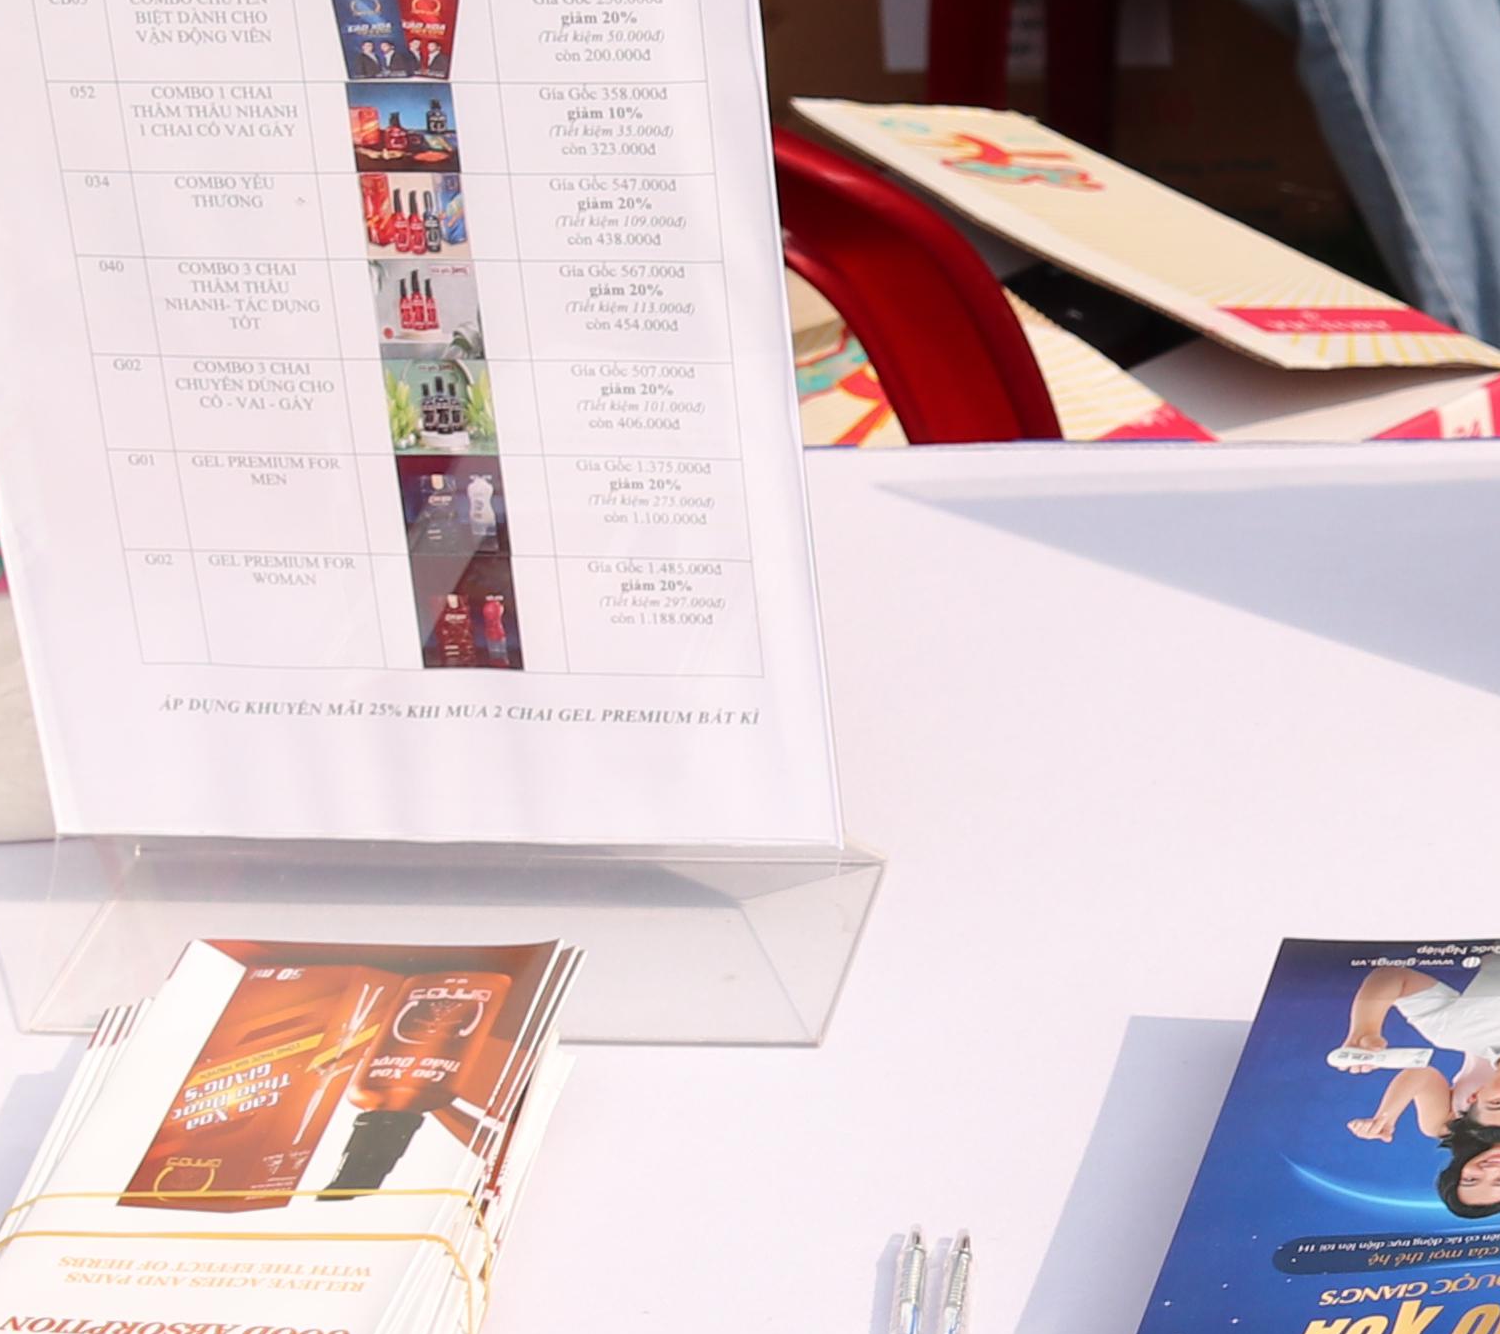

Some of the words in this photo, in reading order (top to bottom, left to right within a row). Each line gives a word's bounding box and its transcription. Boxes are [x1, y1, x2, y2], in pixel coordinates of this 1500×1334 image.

[602, 12, 638, 25] 20%
[1351, 957, 1454, 967] www.giangs.vn
[1320, 1281, 1428, 1306] GIANG'S
